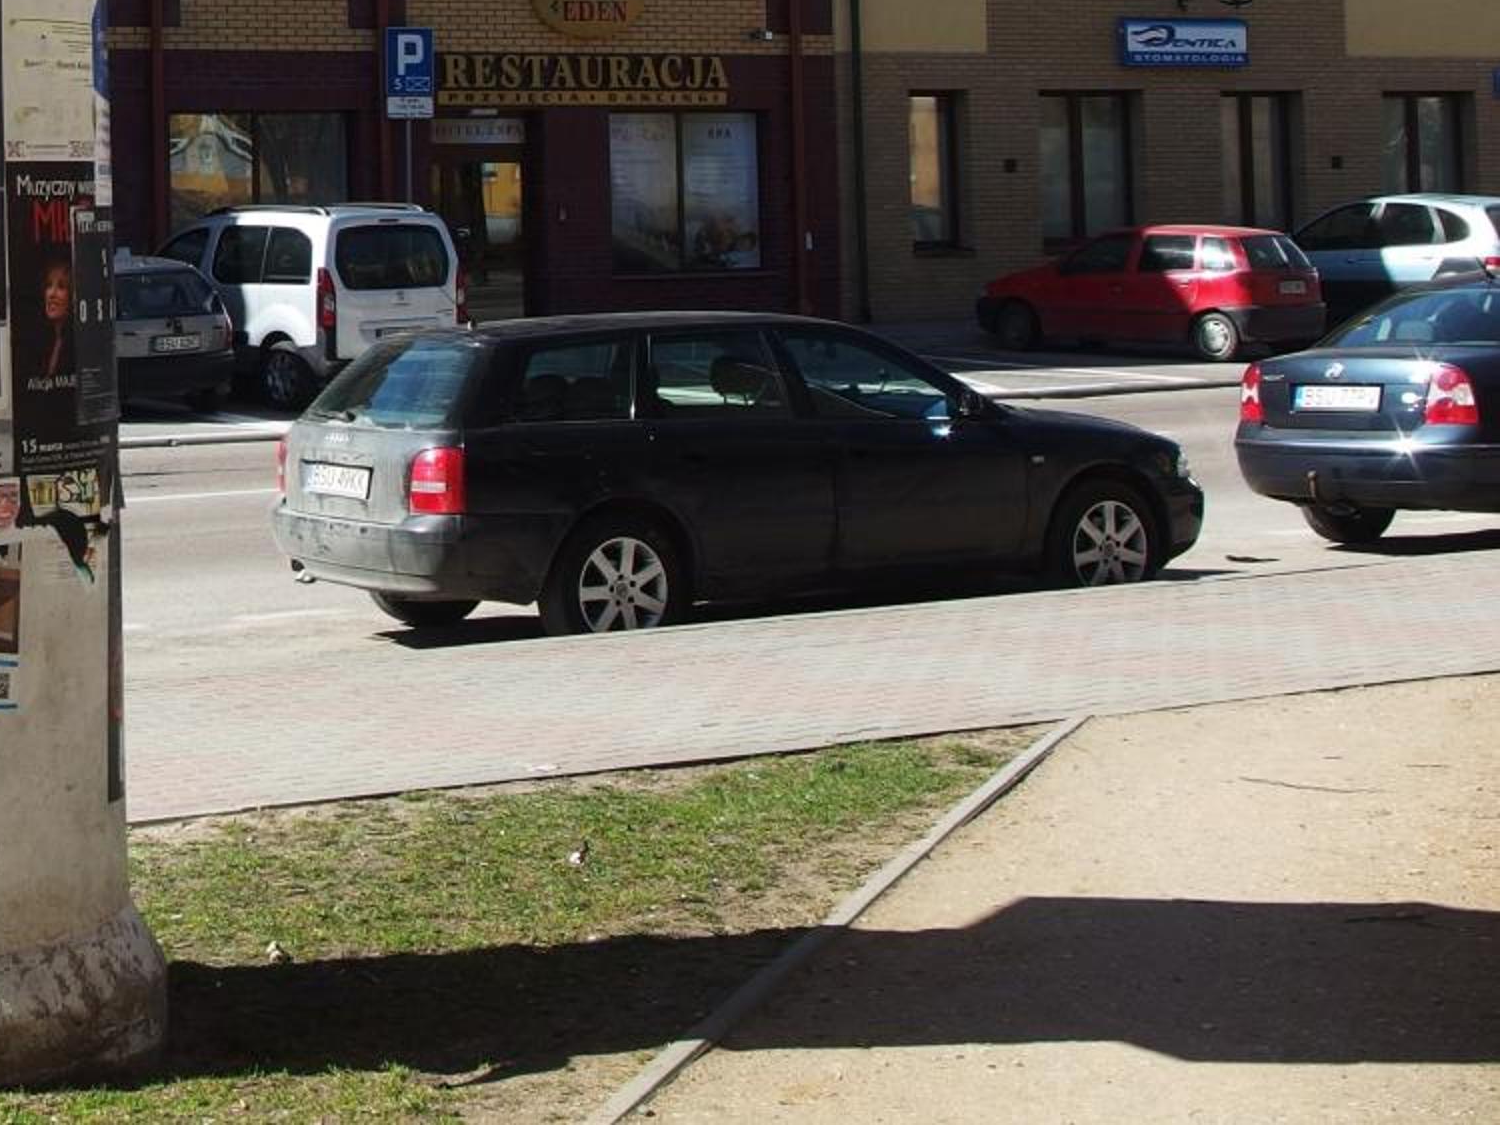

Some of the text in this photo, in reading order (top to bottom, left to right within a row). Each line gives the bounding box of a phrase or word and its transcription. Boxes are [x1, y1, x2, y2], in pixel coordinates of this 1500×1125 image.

[563, 1, 628, 21] EDEN
[397, 34, 424, 76] P
[1133, 54, 1244, 62] STOMATOLOGIA
[444, 54, 729, 89] RESTAURACJA
[21, 439, 37, 454] 15
